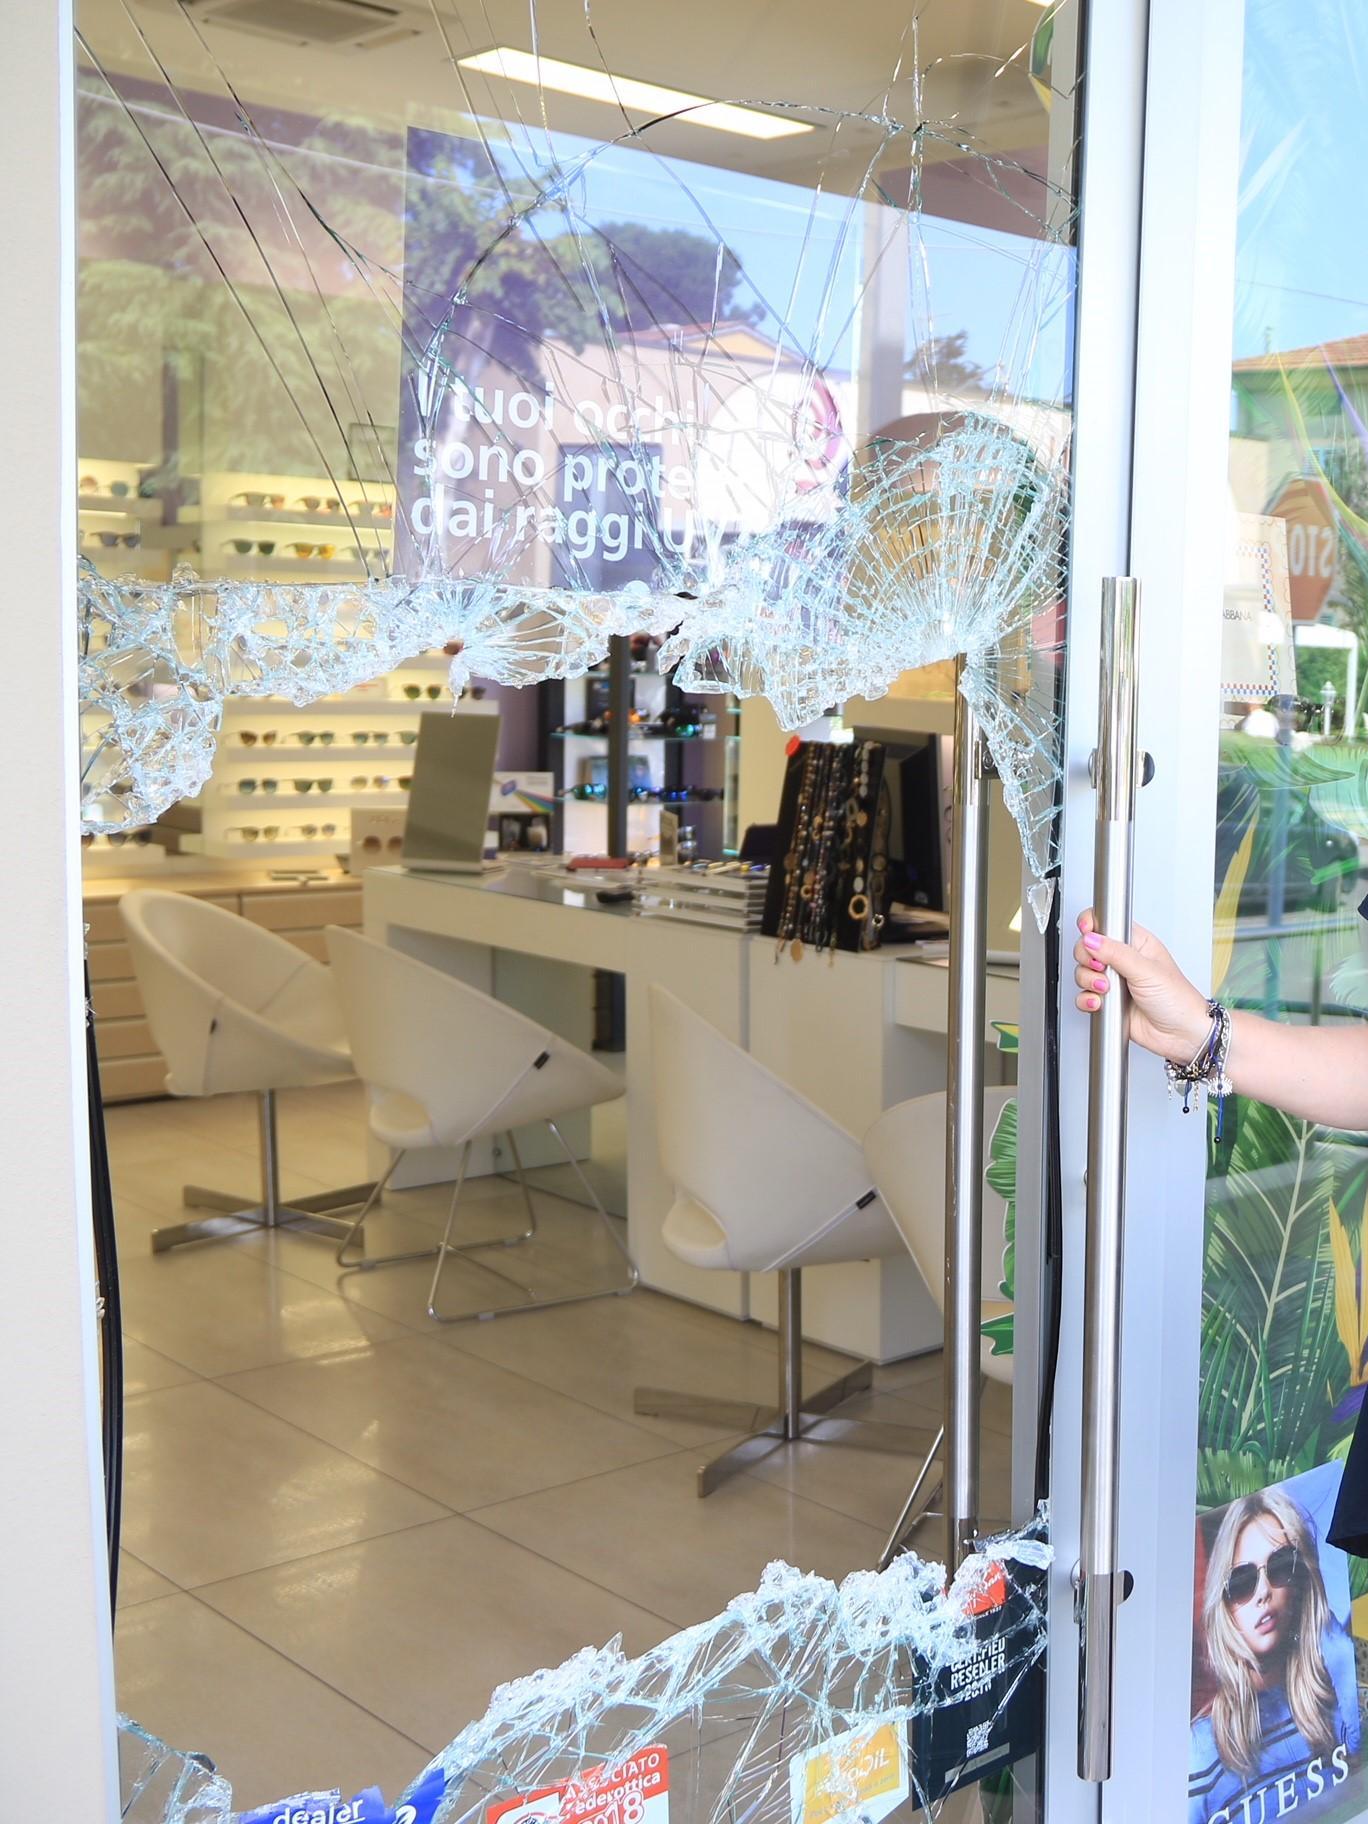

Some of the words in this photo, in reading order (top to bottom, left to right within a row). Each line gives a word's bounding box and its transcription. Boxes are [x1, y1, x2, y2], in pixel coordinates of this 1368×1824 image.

[452, 377, 554, 431] tuoi
[573, 395, 695, 446] occhi
[412, 437, 545, 486] sono
[563, 453, 694, 502] prote
[411, 484, 494, 539] dai
[515, 501, 643, 562] raggi
[564, 1753, 660, 1802] ASCIATO
[272, 1799, 364, 1824] dealer
